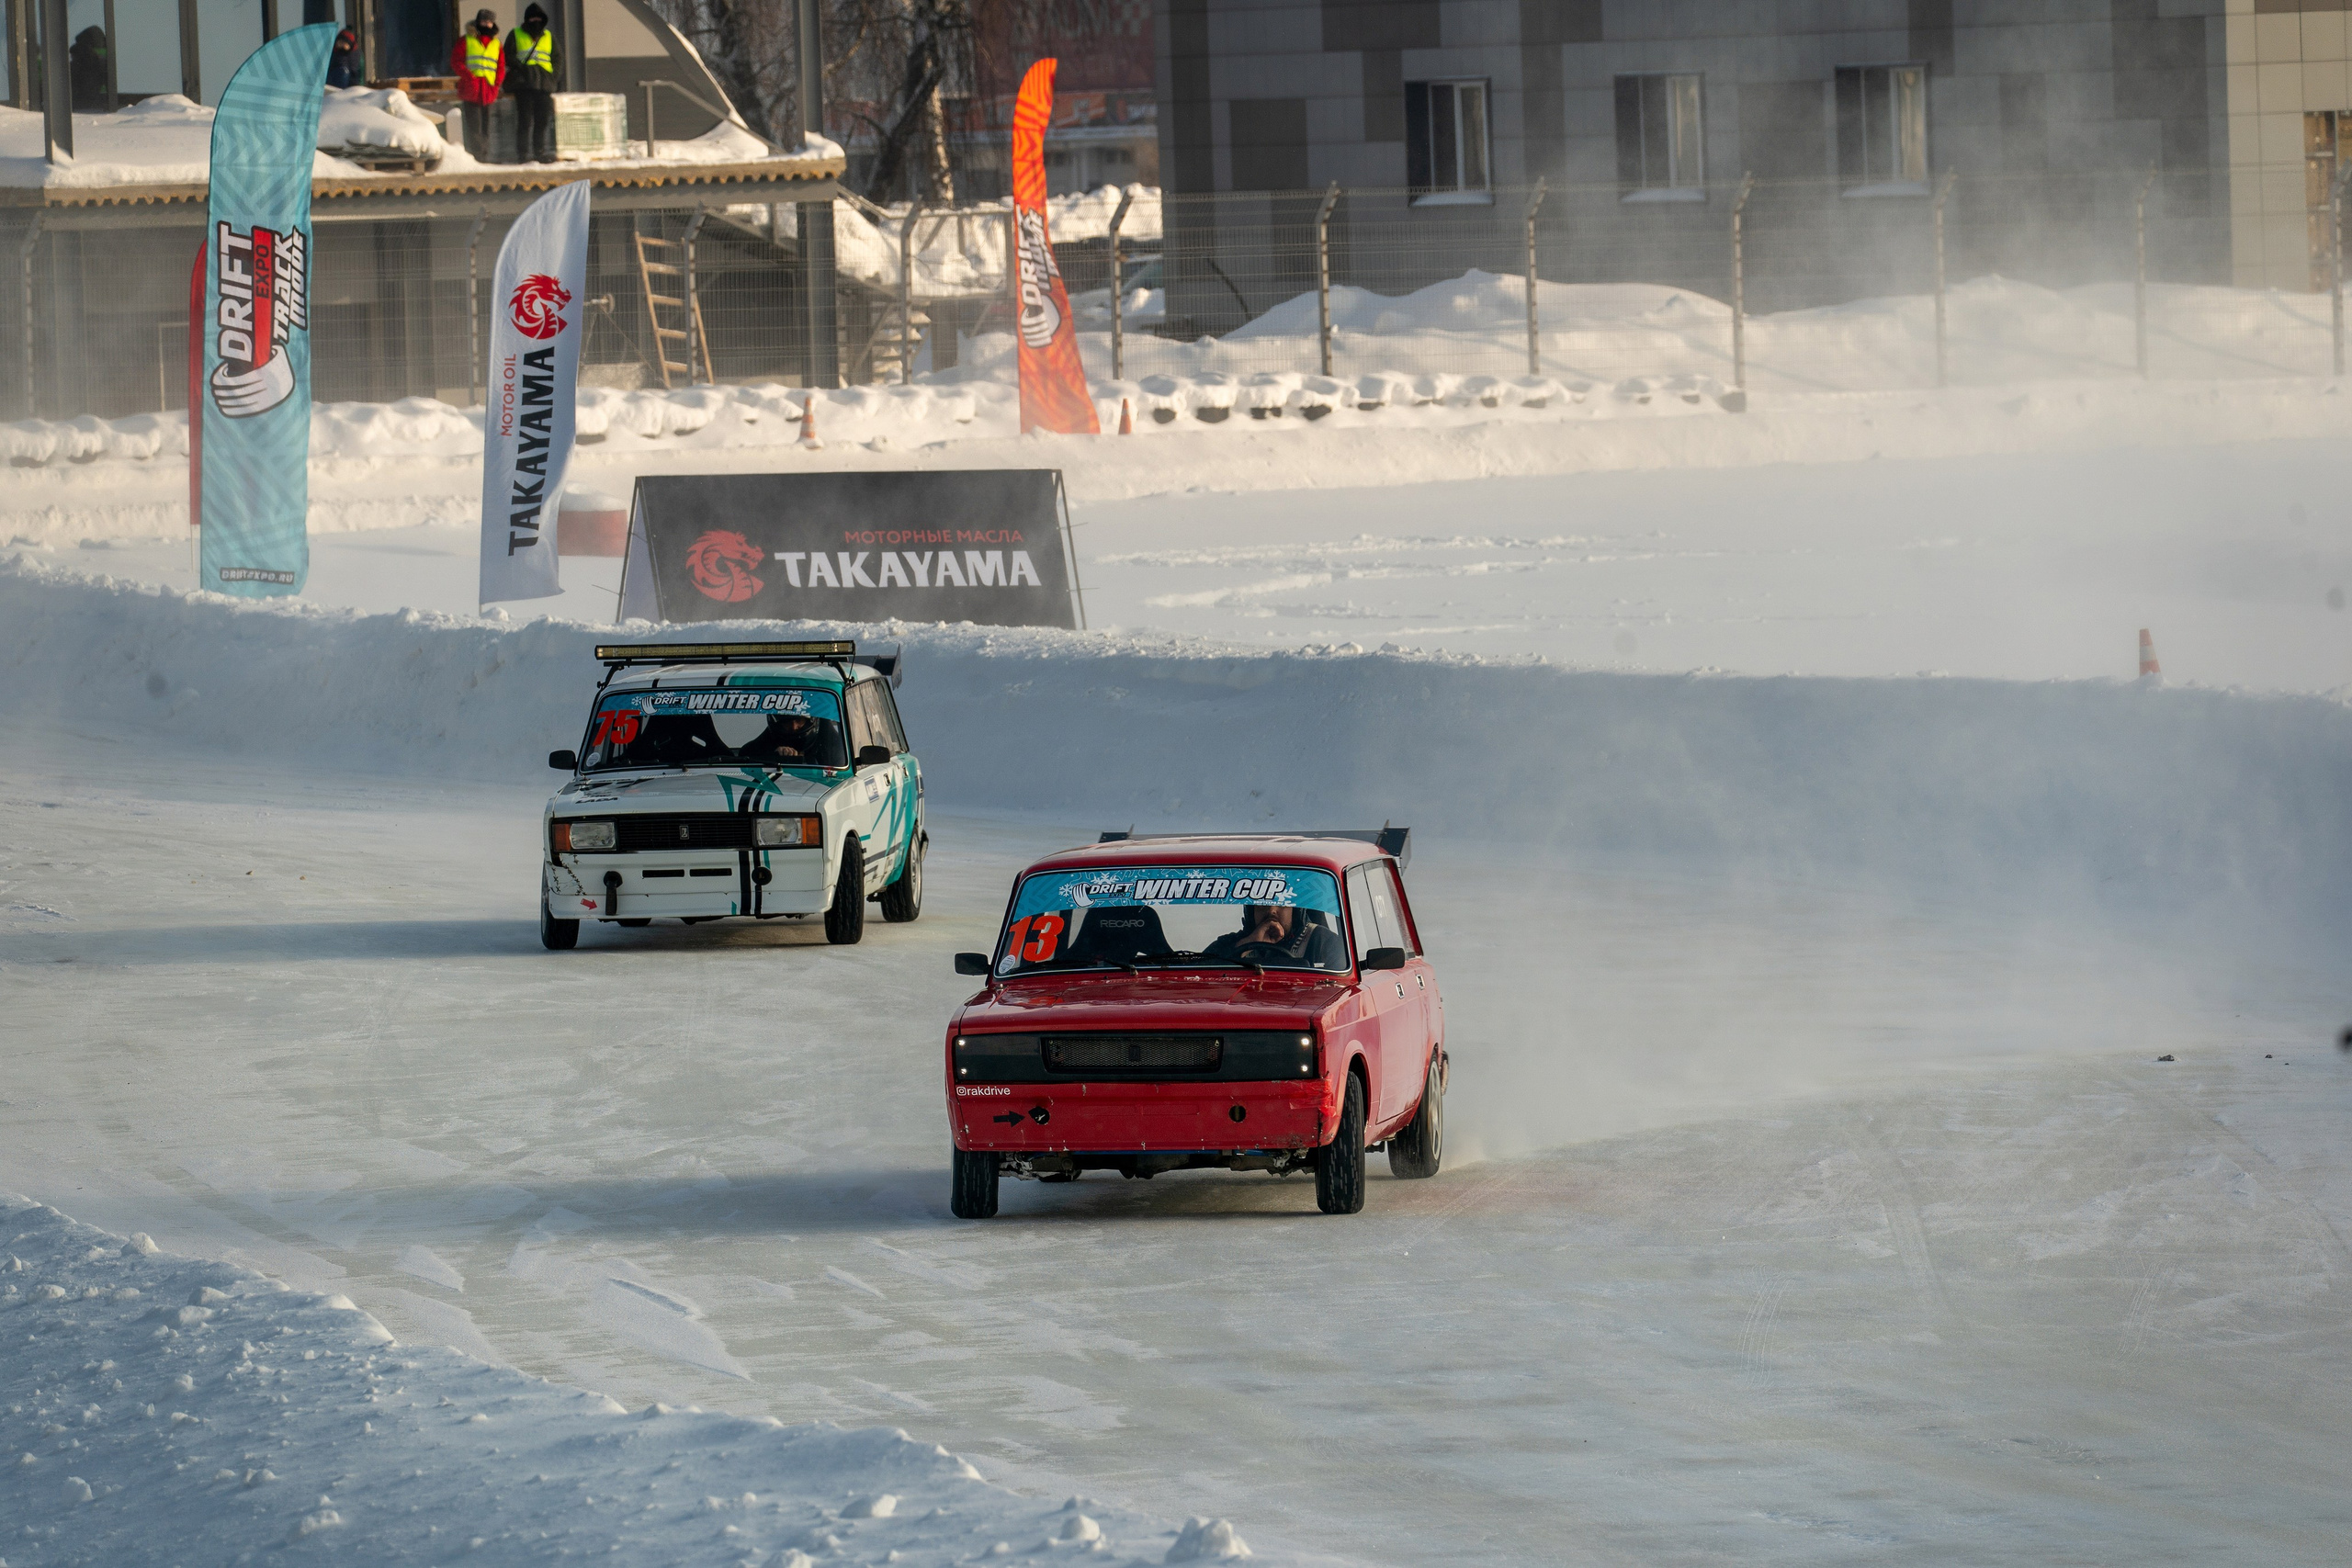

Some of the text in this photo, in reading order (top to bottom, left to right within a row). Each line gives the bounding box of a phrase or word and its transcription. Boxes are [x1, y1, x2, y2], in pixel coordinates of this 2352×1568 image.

[255, 244, 269, 299] EXPO
[1016, 203, 1043, 305] DRIFT
[220, 222, 253, 363] DRIFT
[501, 353, 516, 436] MOTOR OIL
[508, 346, 555, 557] TAKAYAMA
[844, 528, 1023, 545] МОТОРНЫЕ МАСЛА
[775, 550, 1042, 588] TAKAYAMA
[654, 694, 802, 710] DRIFT WINTER CUP
[593, 709, 640, 747] 75
[1090, 878, 1286, 900] DRIFT WINTER CUP
[1009, 915, 1064, 963] 13
[1100, 919, 1145, 928] RECARO
